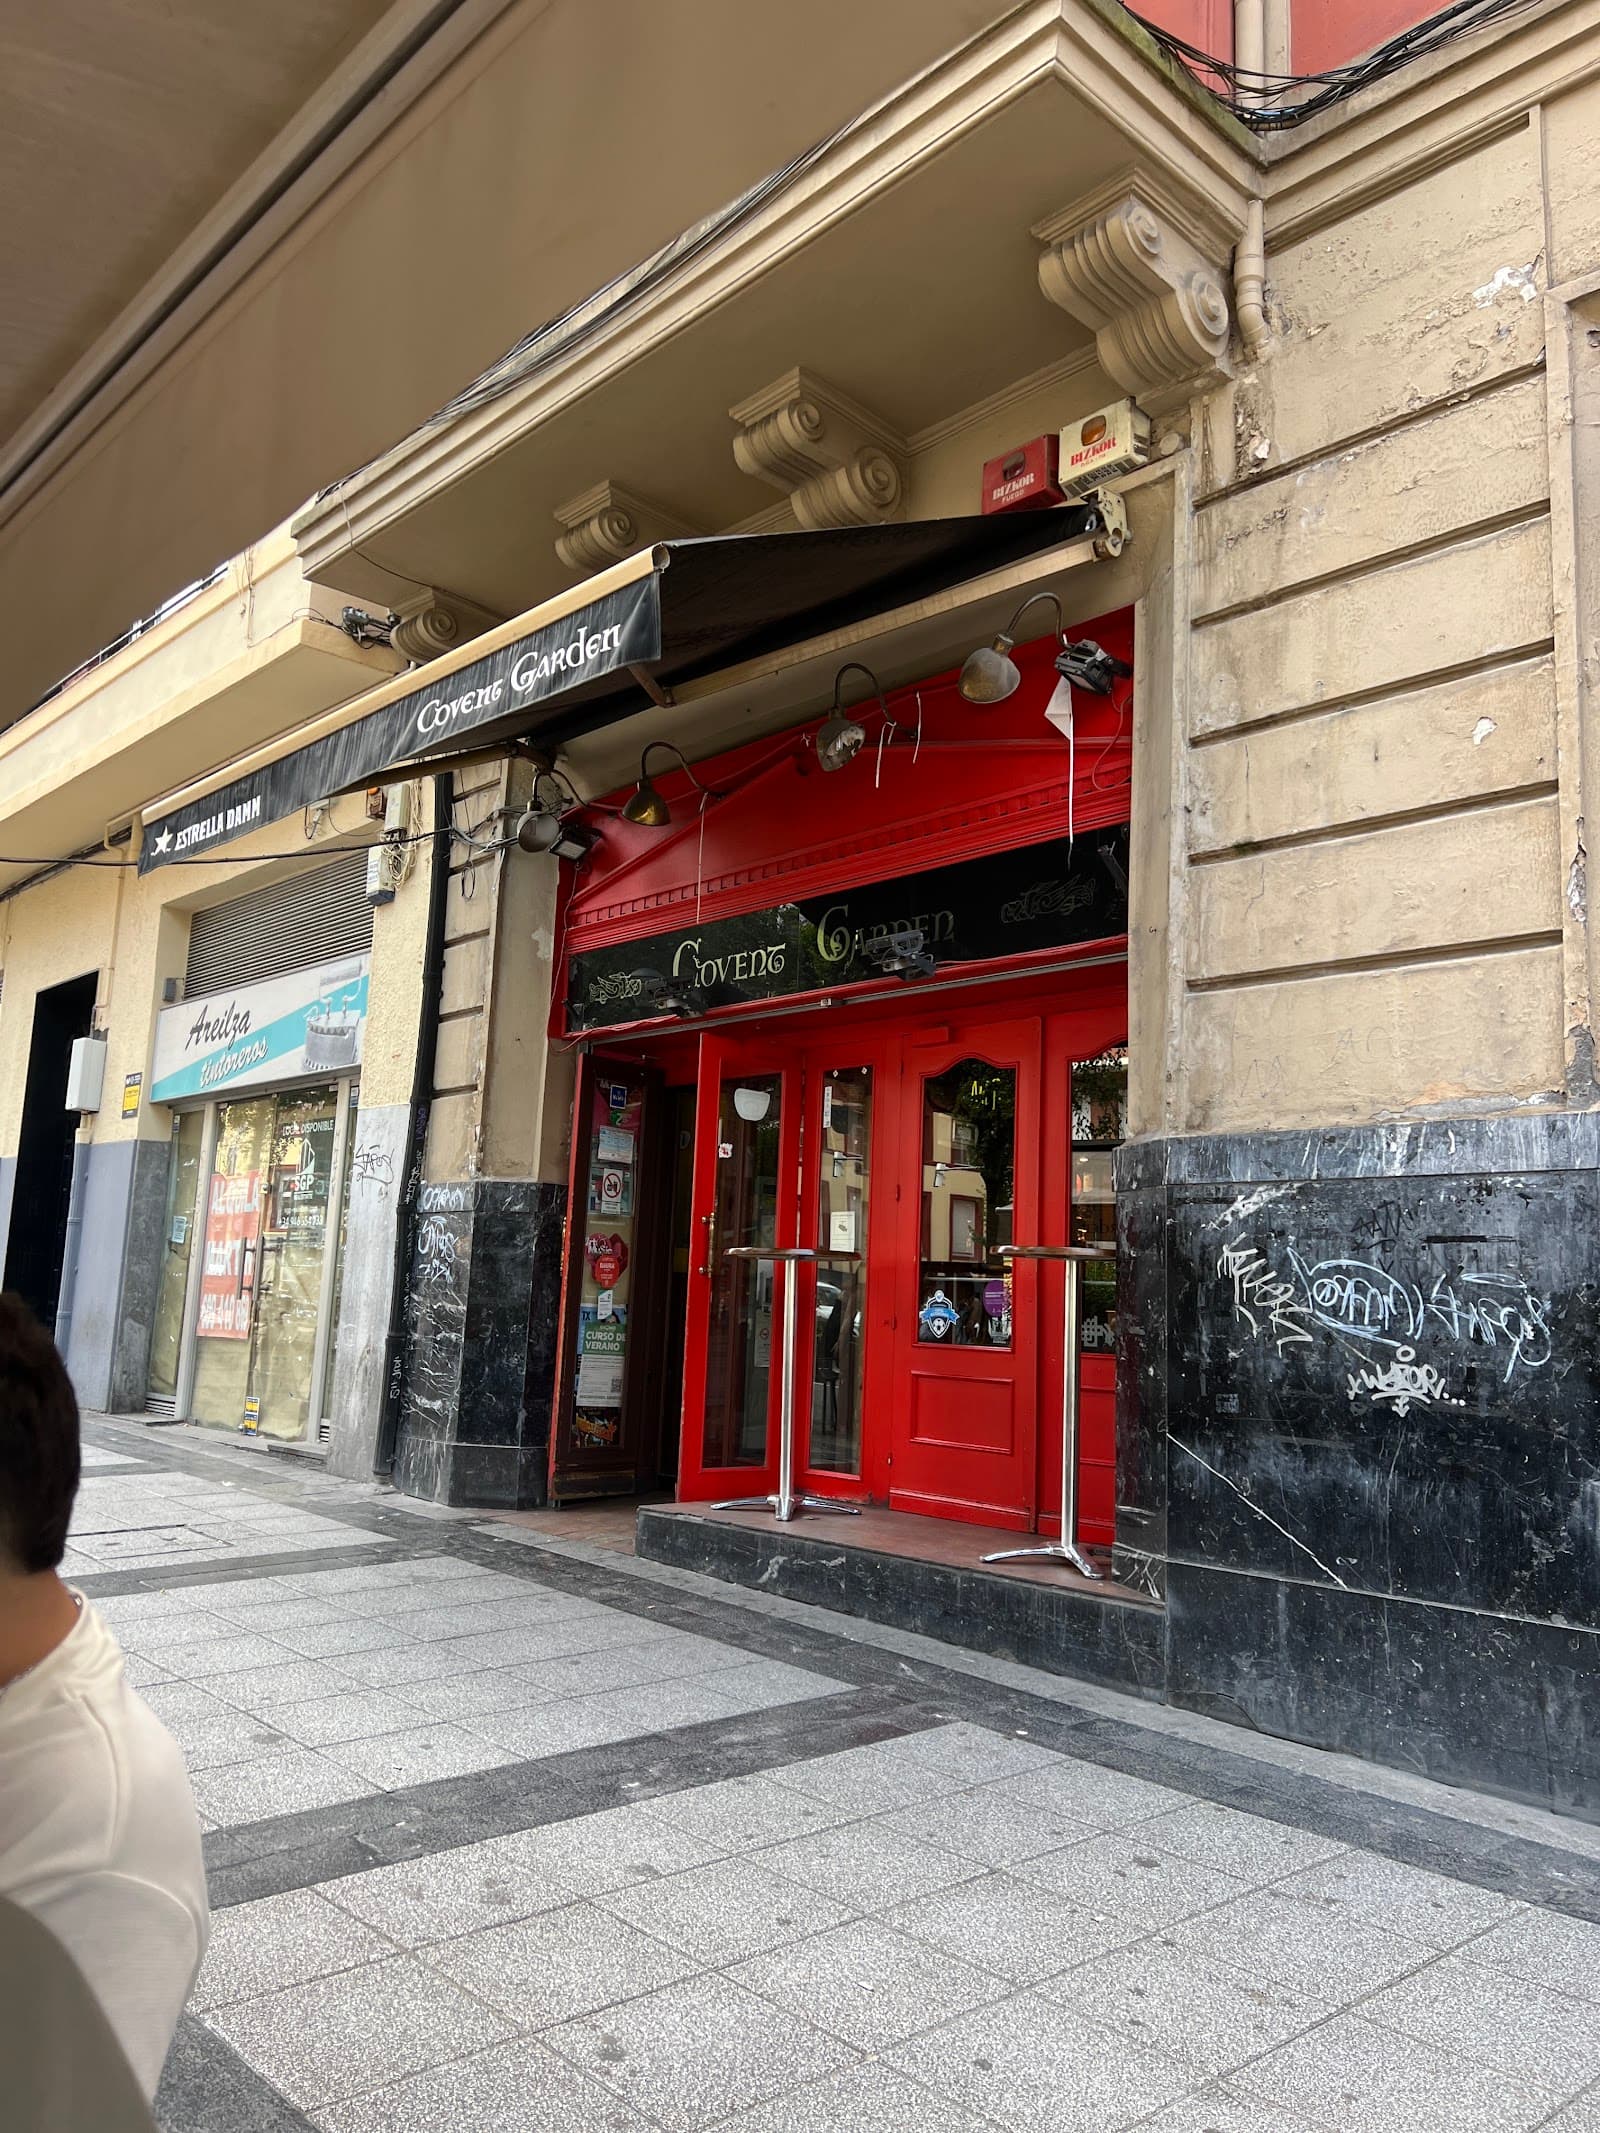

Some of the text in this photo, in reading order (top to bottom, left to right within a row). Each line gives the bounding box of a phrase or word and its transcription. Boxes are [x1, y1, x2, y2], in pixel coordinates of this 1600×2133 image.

[1071, 438, 1117, 466] BIZKOR
[992, 472, 1035, 500] BIZKOR
[174, 795, 261, 851] ESTRELLA DAMM
[185, 1000, 252, 1052] Areilza
[201, 1035, 269, 1088] tintoreros
[301, 1119, 334, 1134] DISPONIBLE
[295, 1174, 315, 1191] SGP
[585, 1330, 614, 1342] CURSO
[585, 1341, 620, 1351] VERANO
